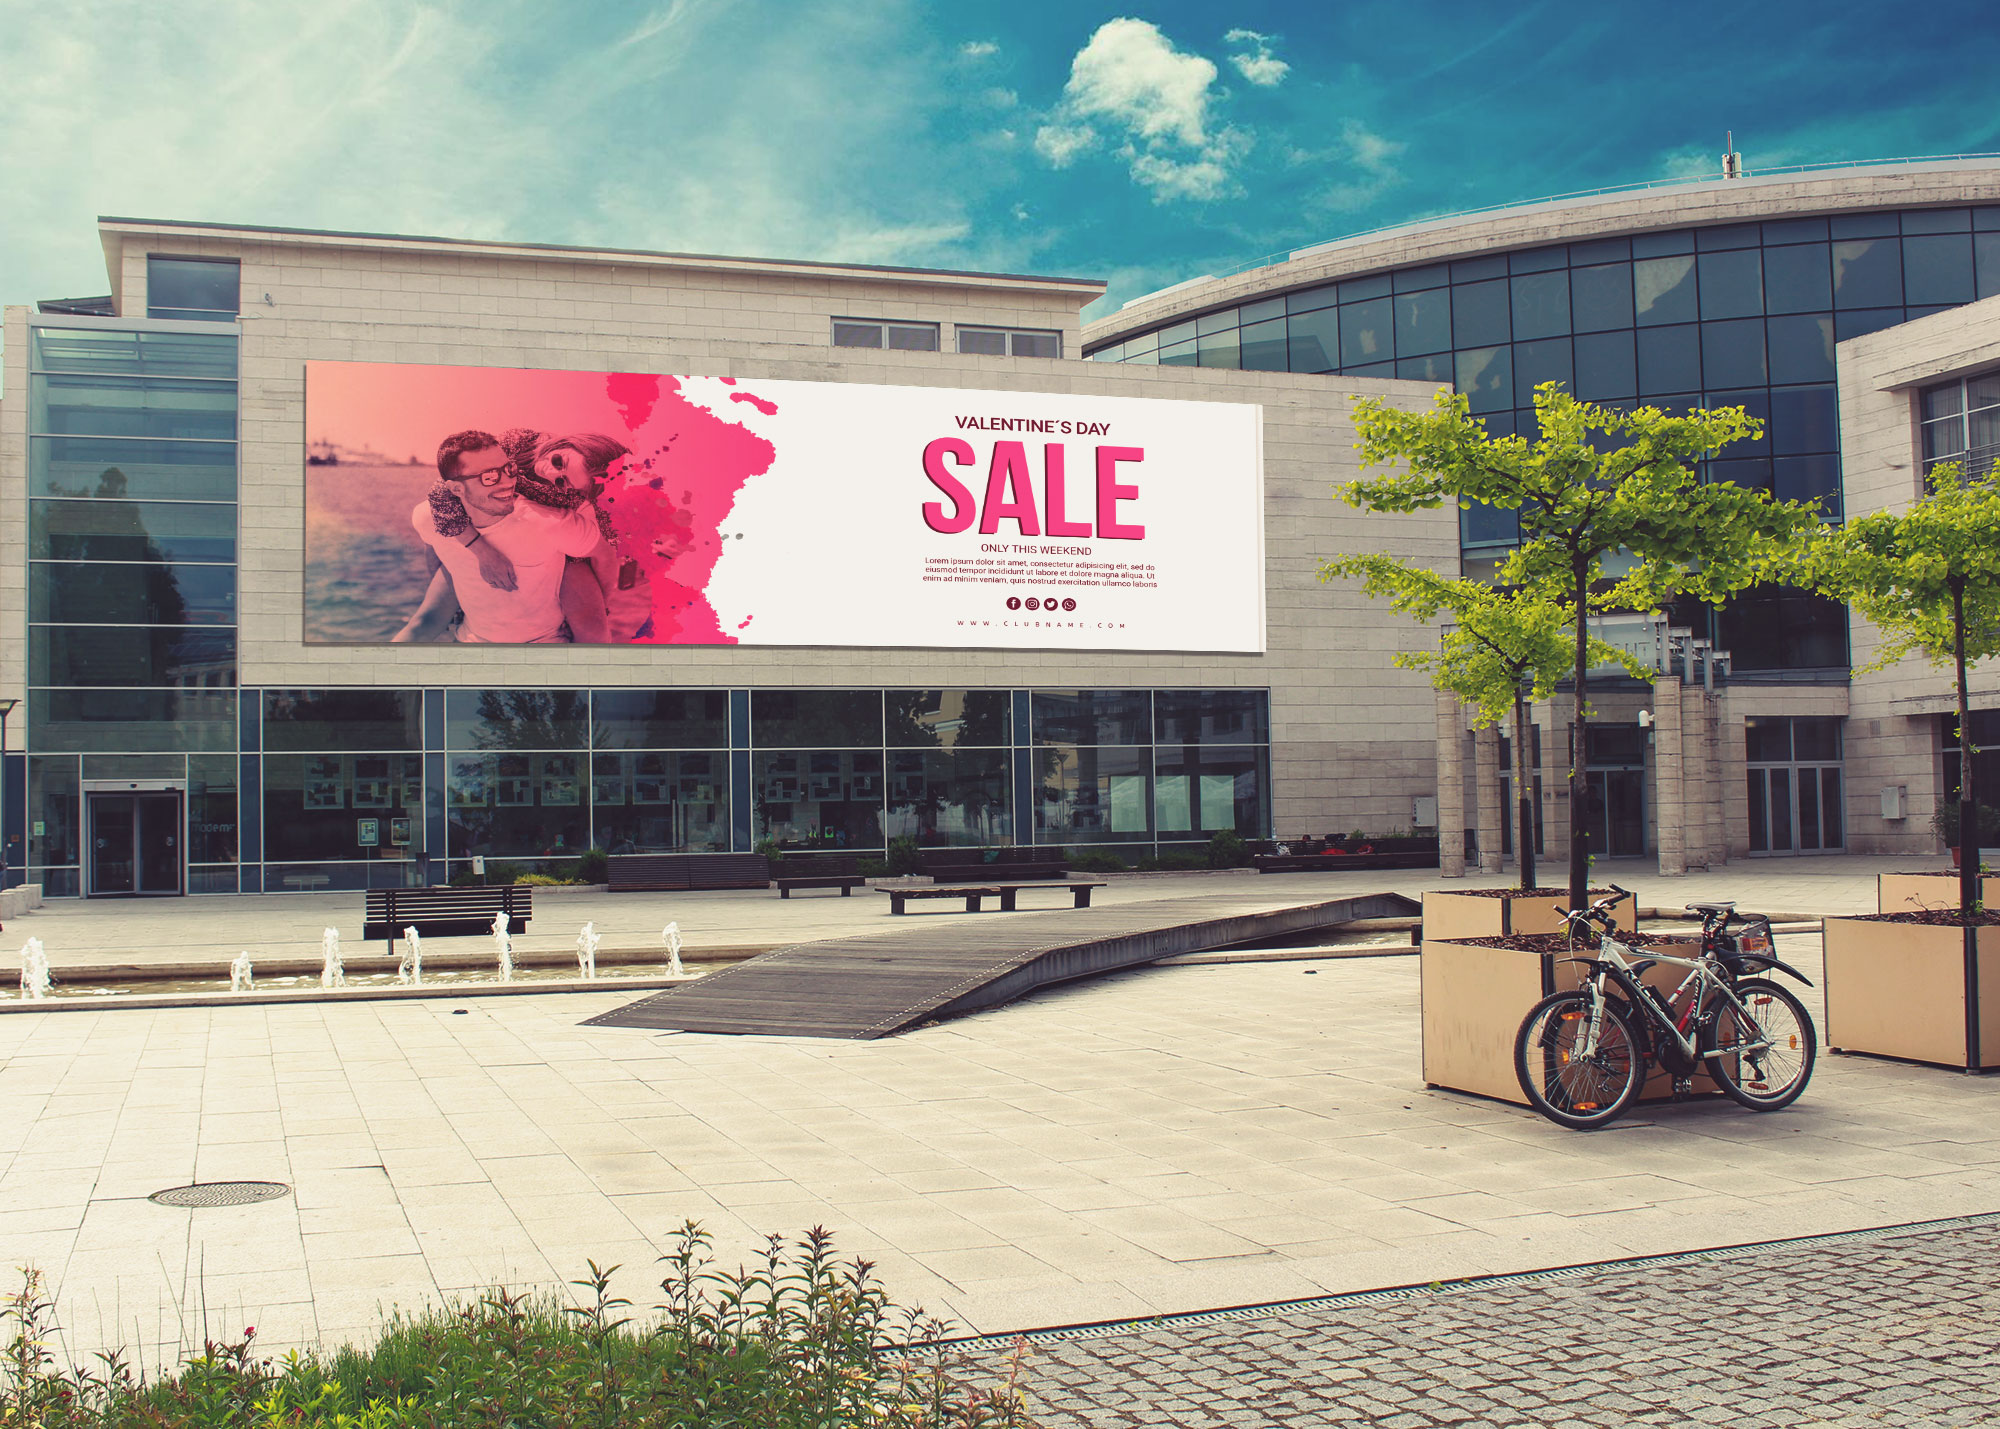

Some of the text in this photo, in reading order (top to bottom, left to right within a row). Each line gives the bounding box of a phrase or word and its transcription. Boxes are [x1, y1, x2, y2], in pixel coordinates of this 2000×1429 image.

[1077, 422, 1110, 436] DAY
[922, 437, 1145, 540] SALE
[981, 544, 1091, 555] ONLY THIS WEEKEND
[1075, 562, 1114, 570] adipisicing
[1010, 577, 1026, 585] quis
